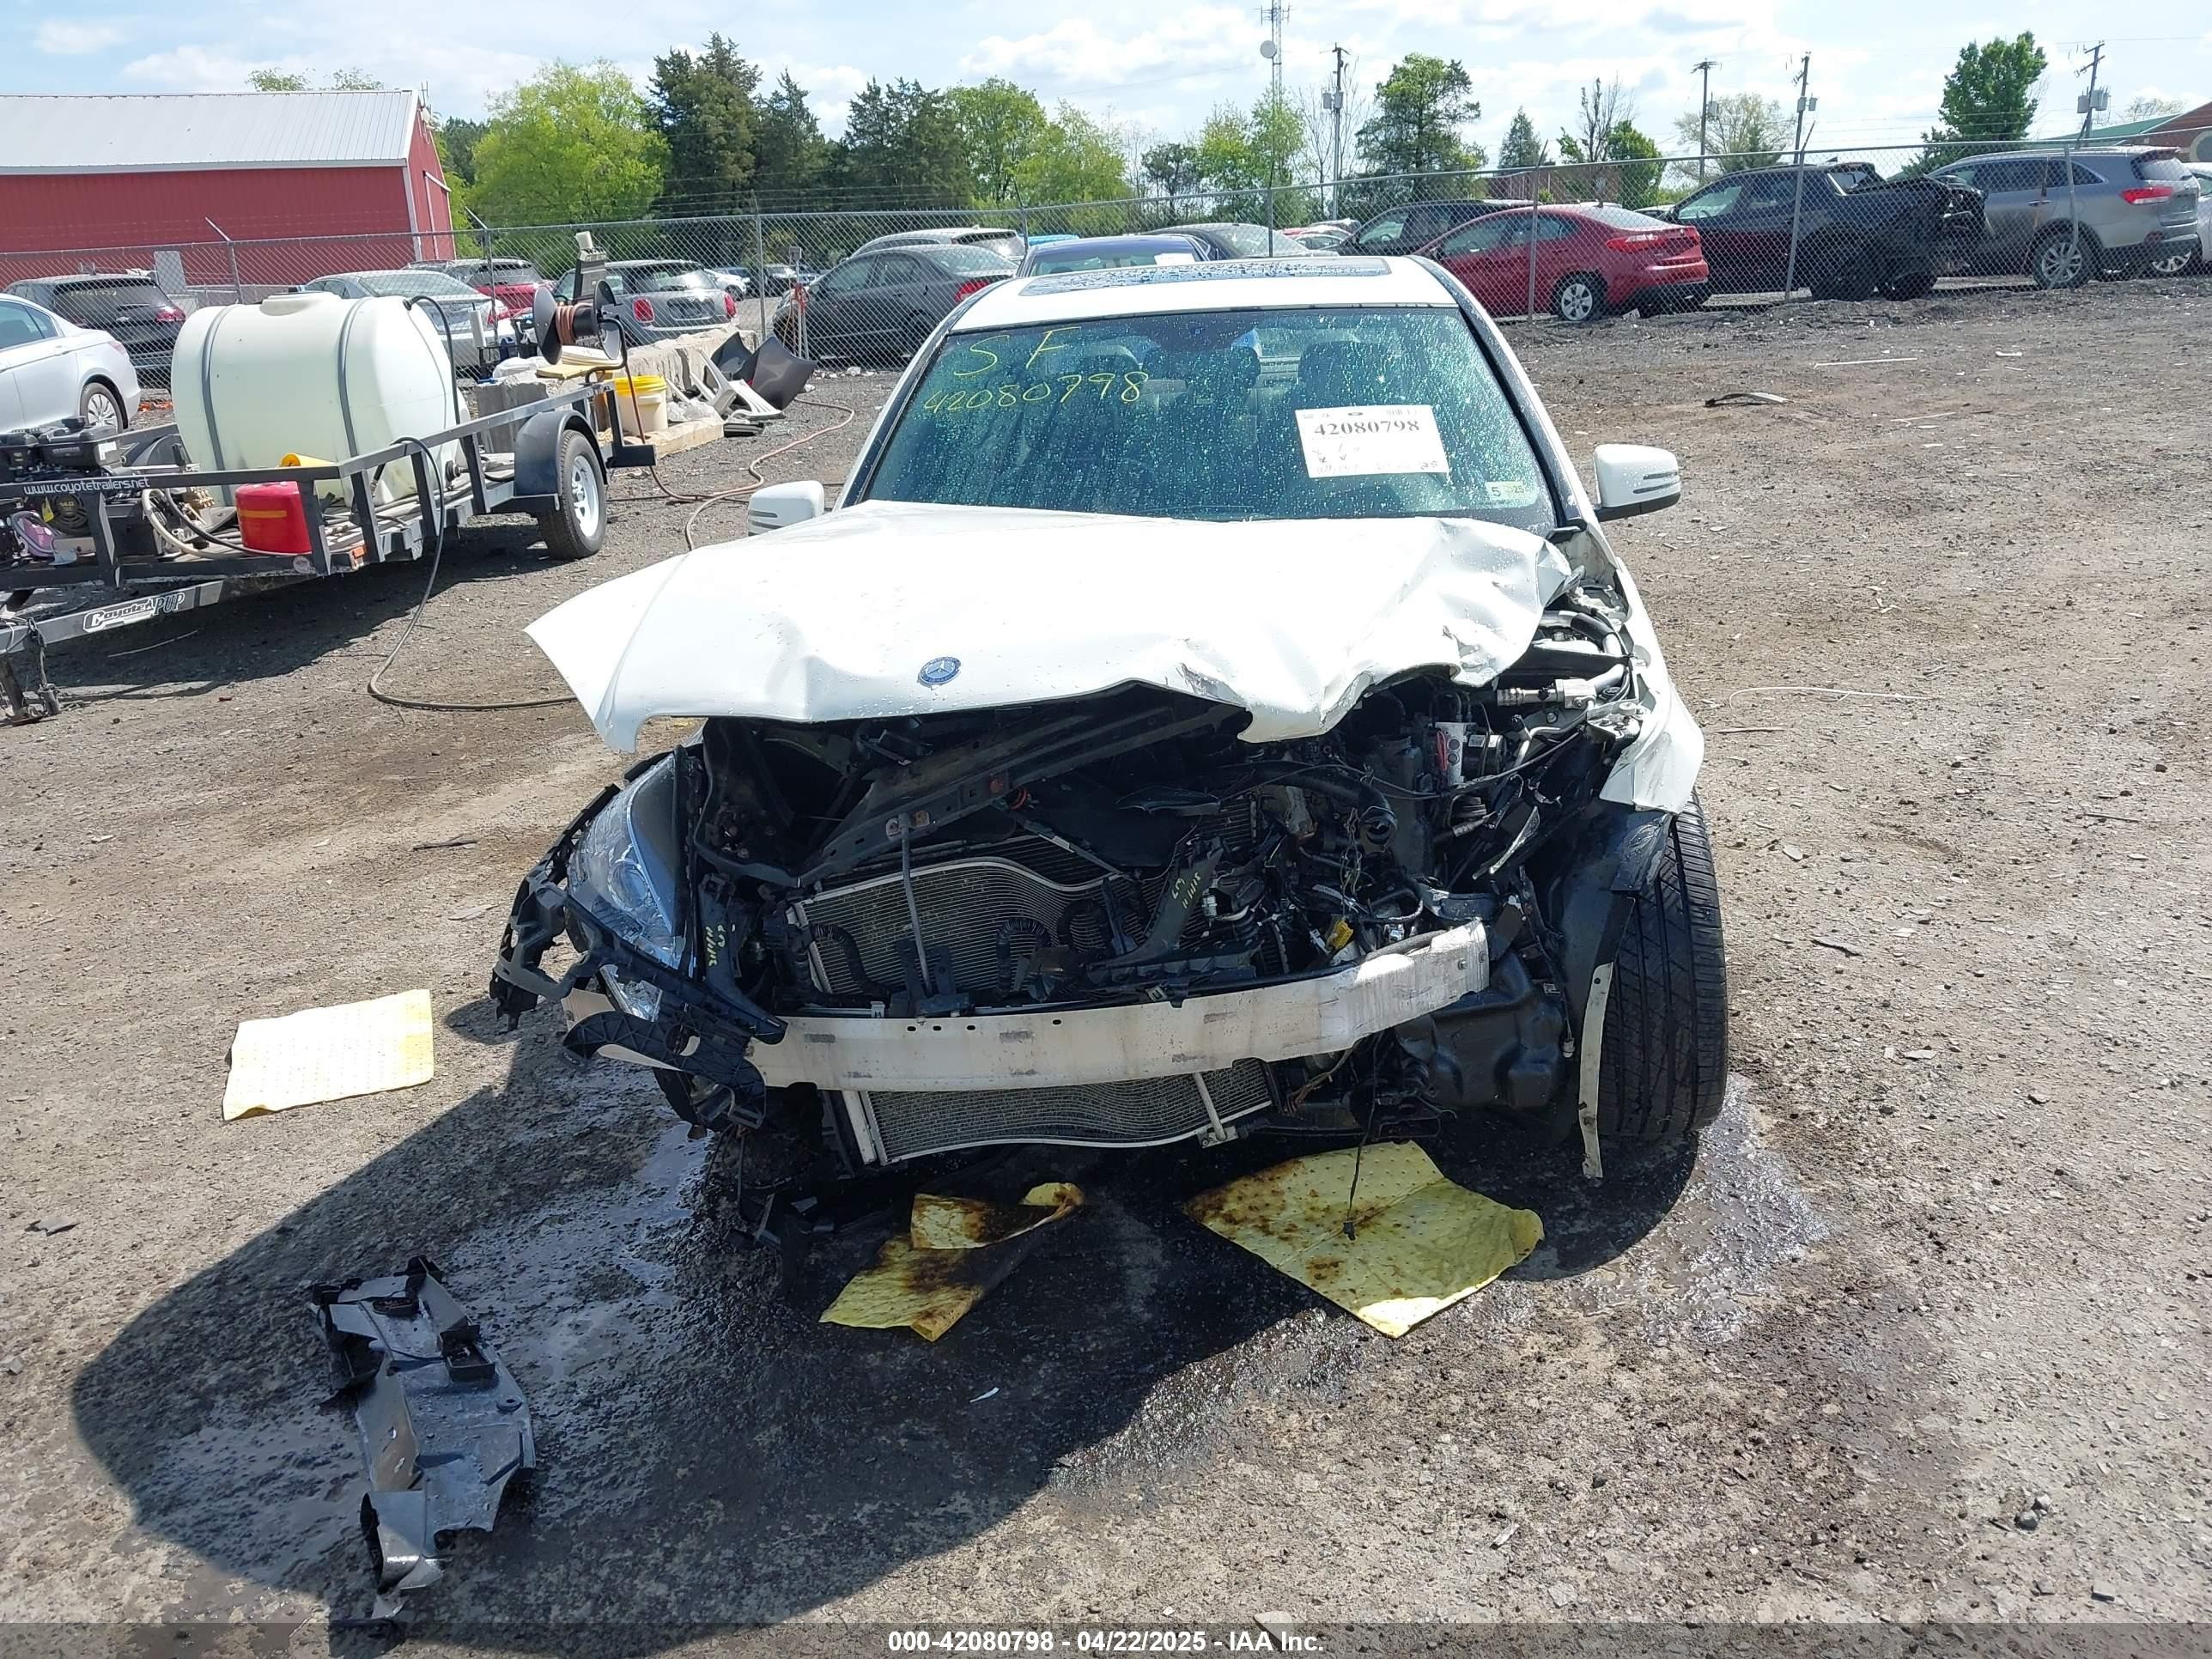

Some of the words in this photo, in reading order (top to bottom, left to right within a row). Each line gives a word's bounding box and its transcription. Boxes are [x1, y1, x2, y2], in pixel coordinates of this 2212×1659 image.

[953, 334, 1010, 376] S
[1026, 325, 1081, 370] F
[924, 371, 1149, 414] 42080798
[1314, 420, 1420, 435] 42080798
[23, 477, 151, 495] www.coyotetrailers.net
